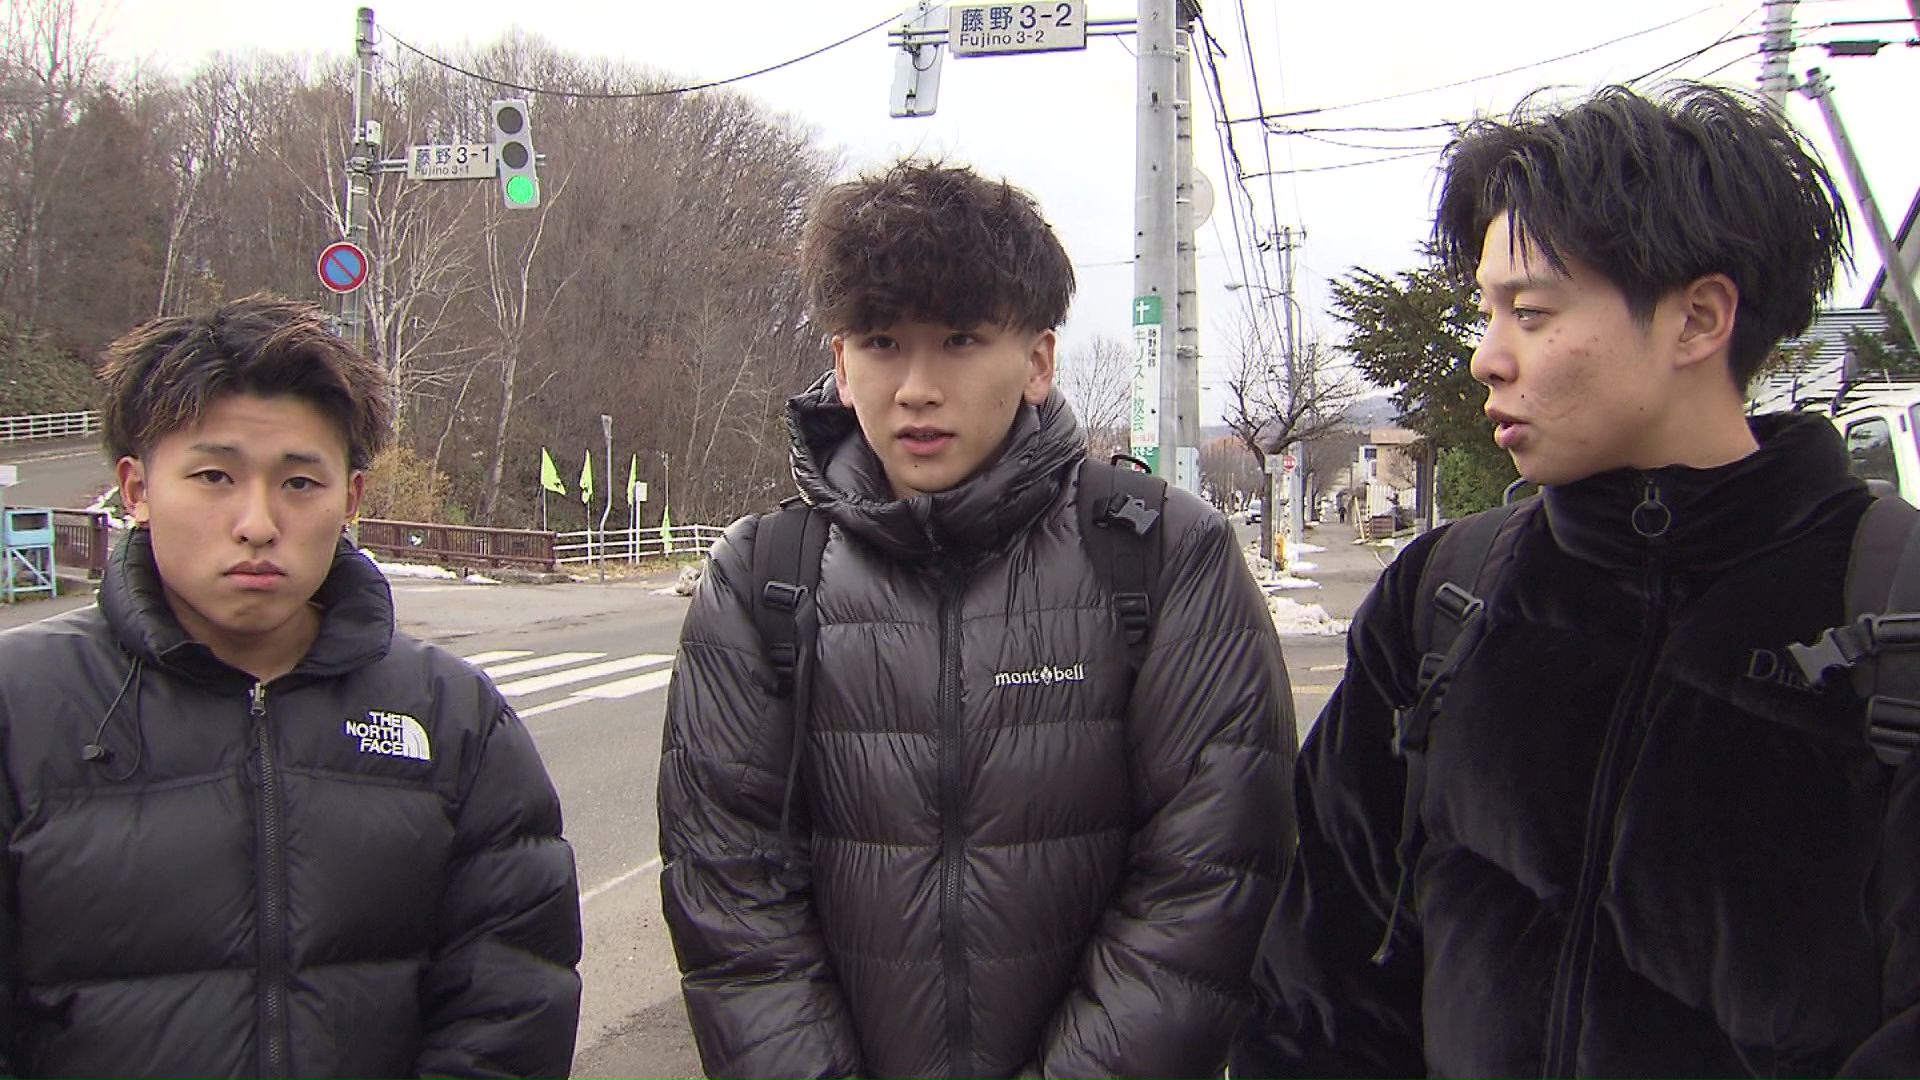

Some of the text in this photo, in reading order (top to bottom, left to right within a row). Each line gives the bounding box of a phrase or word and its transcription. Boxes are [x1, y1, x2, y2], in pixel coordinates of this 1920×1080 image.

[960, 31, 1044, 48] Fujino 3-2
[415, 165, 469, 177] Fujino 3-1
[368, 711, 403, 728] THE
[346, 720, 402, 743] NORTH
[360, 738, 404, 756] FACE
